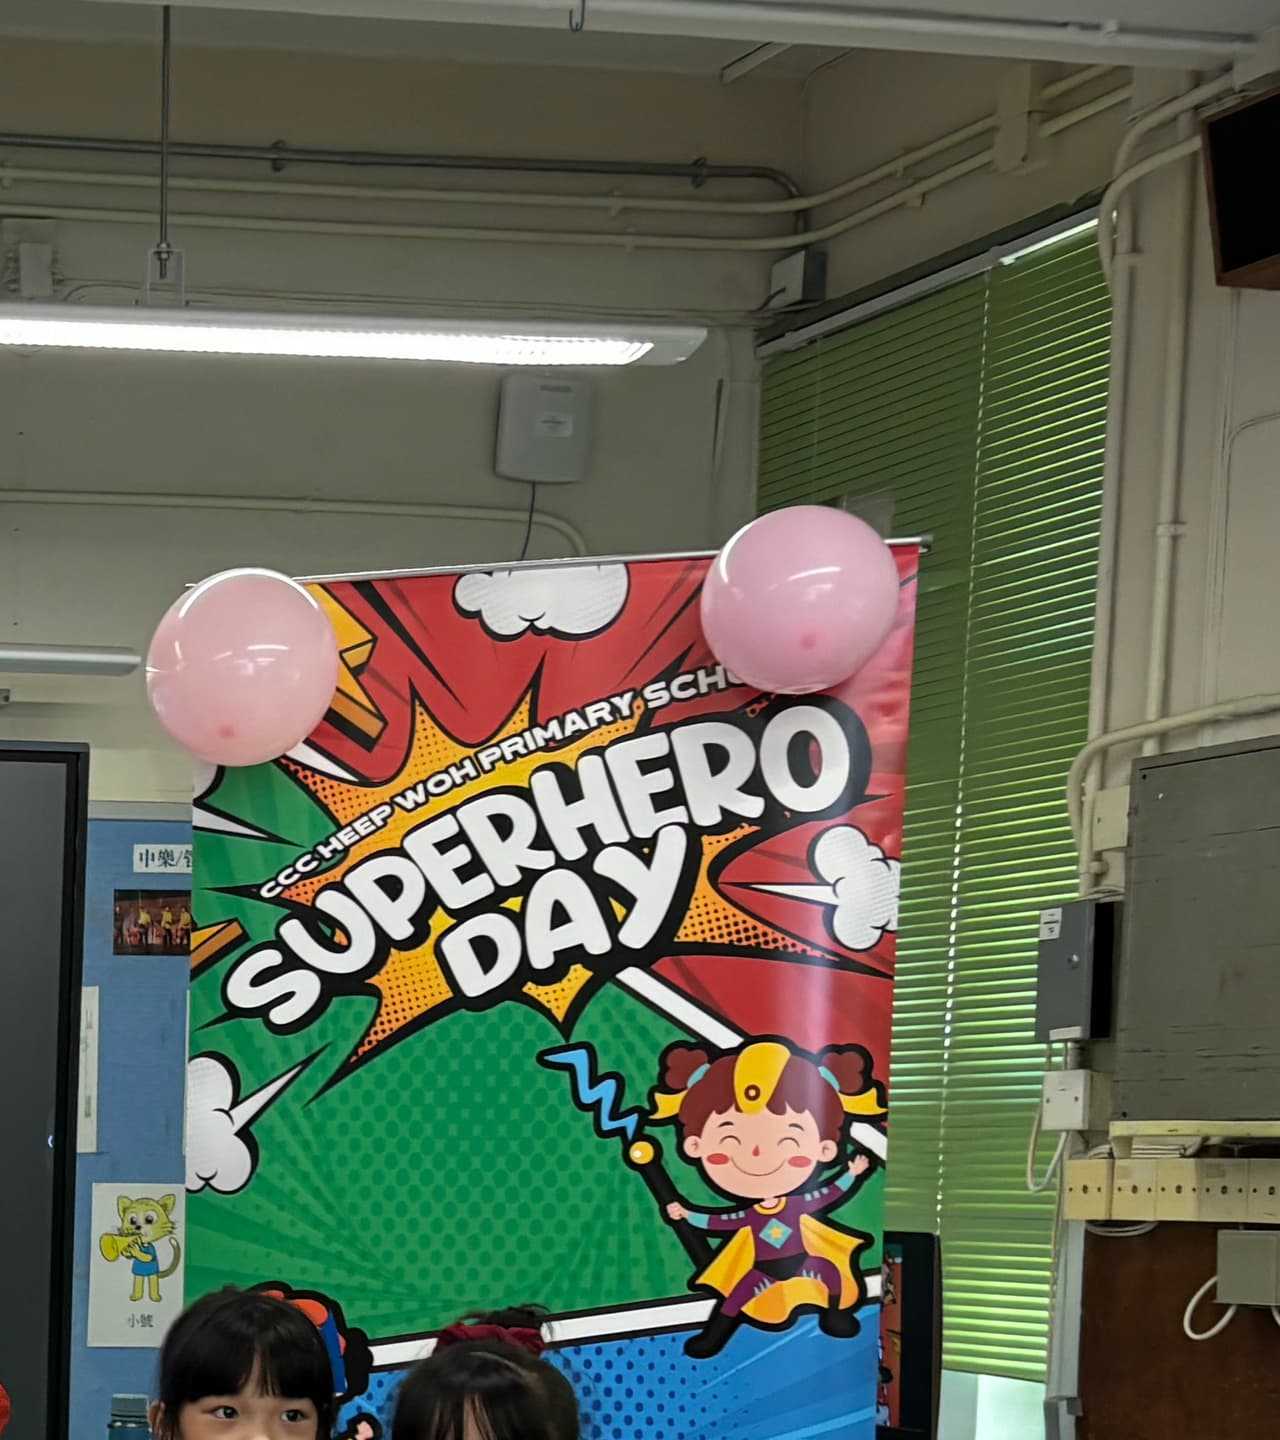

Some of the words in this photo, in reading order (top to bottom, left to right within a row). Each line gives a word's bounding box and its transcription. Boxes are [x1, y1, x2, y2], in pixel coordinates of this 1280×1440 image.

[225, 705, 851, 1027] SUPERHERO
[259, 853, 319, 899] CCC
[316, 803, 393, 859] HEEP
[394, 758, 478, 811] WOH
[477, 691, 635, 772] PRIMARY
[642, 664, 747, 709] SCH
[440, 825, 687, 999] DAY
